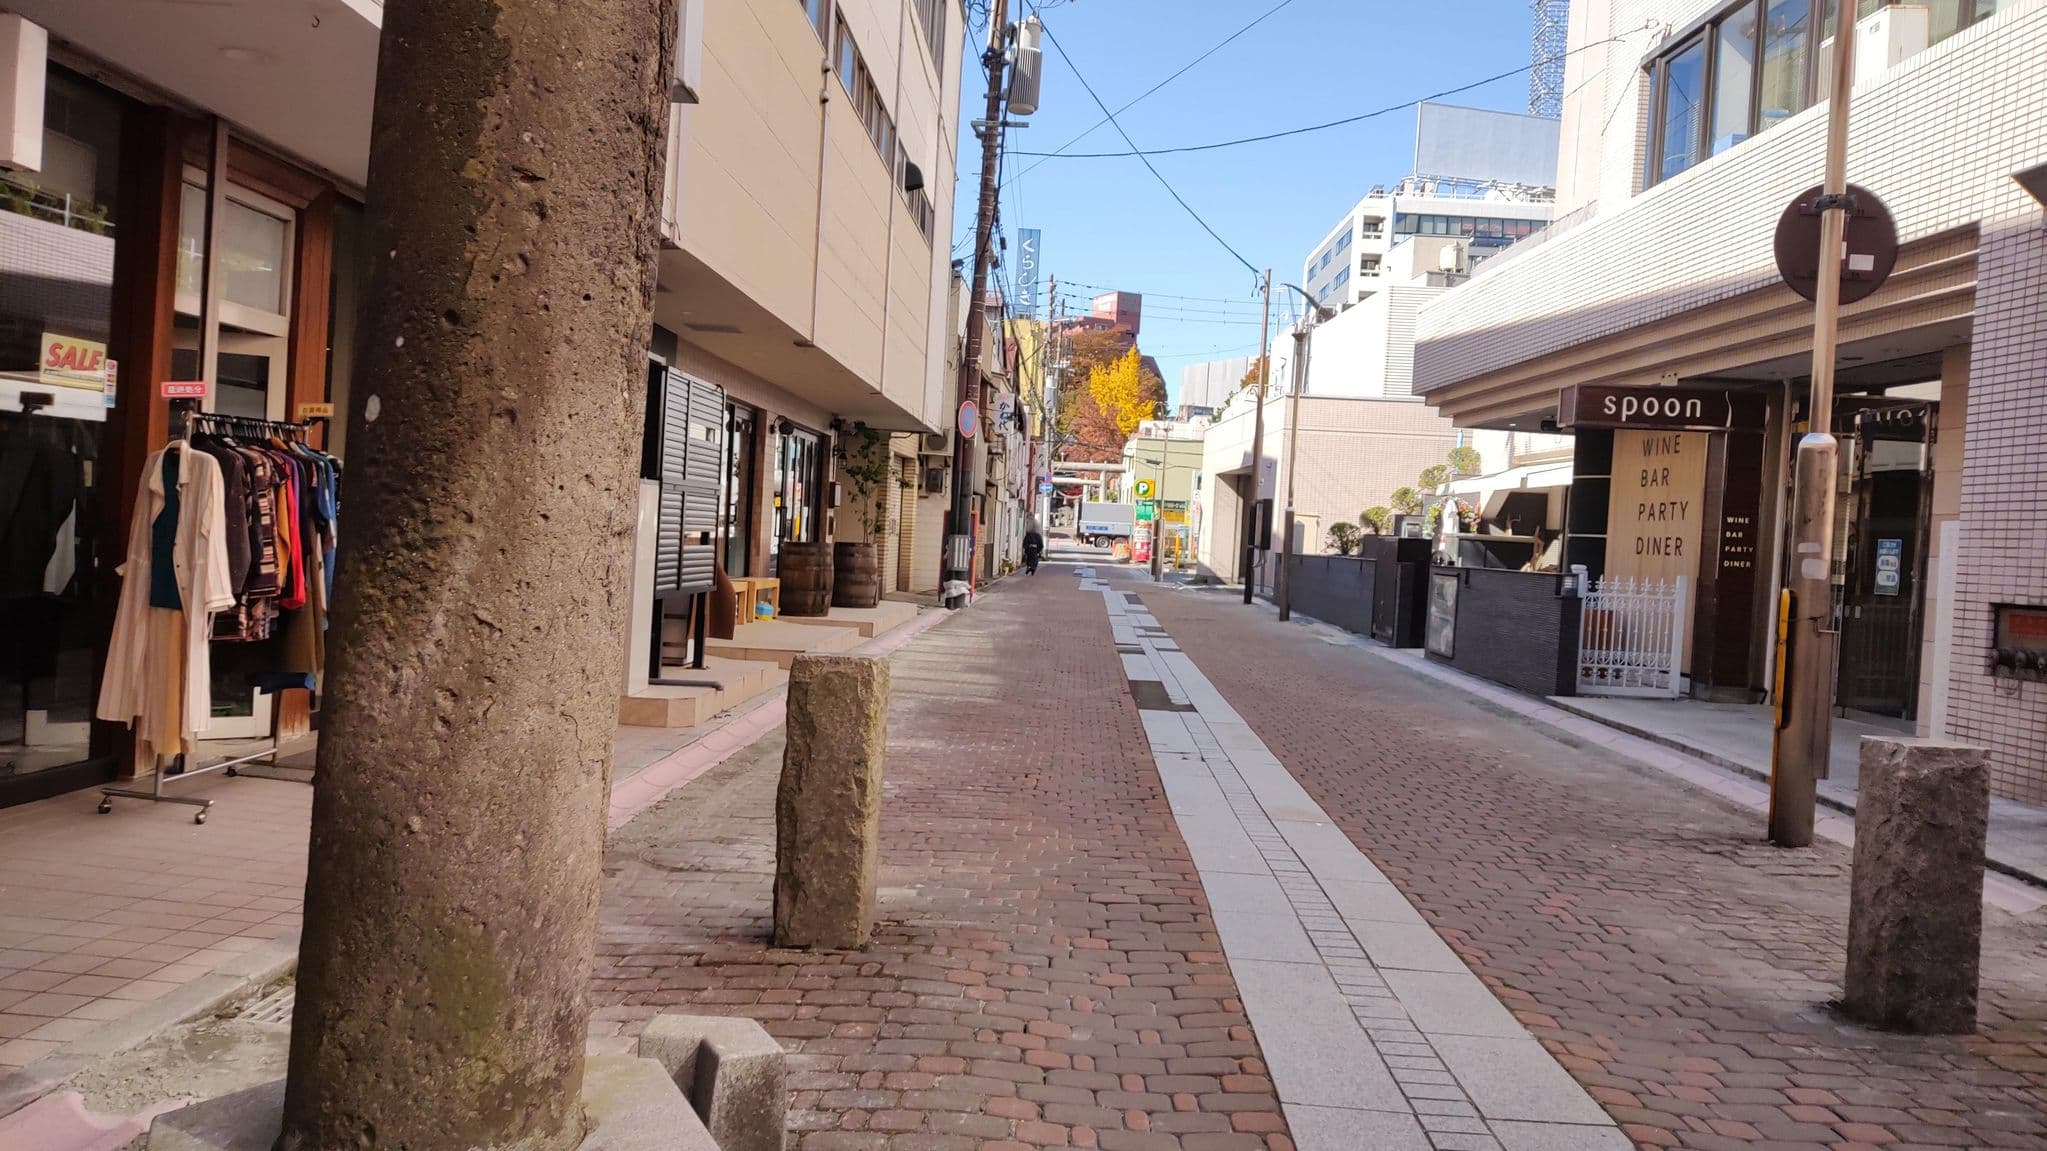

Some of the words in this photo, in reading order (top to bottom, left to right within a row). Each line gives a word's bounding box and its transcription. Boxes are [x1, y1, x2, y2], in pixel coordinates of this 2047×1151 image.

[46, 342, 104, 371] SALE
[1603, 395, 1701, 422] spoon
[1642, 434, 1681, 456] WINE
[1640, 467, 1669, 487] BAR
[1638, 501, 1688, 521] PARTY
[1726, 516, 1750, 524] WINE
[1636, 536, 1683, 557] DINER
[1723, 560, 1751, 568] DINER
